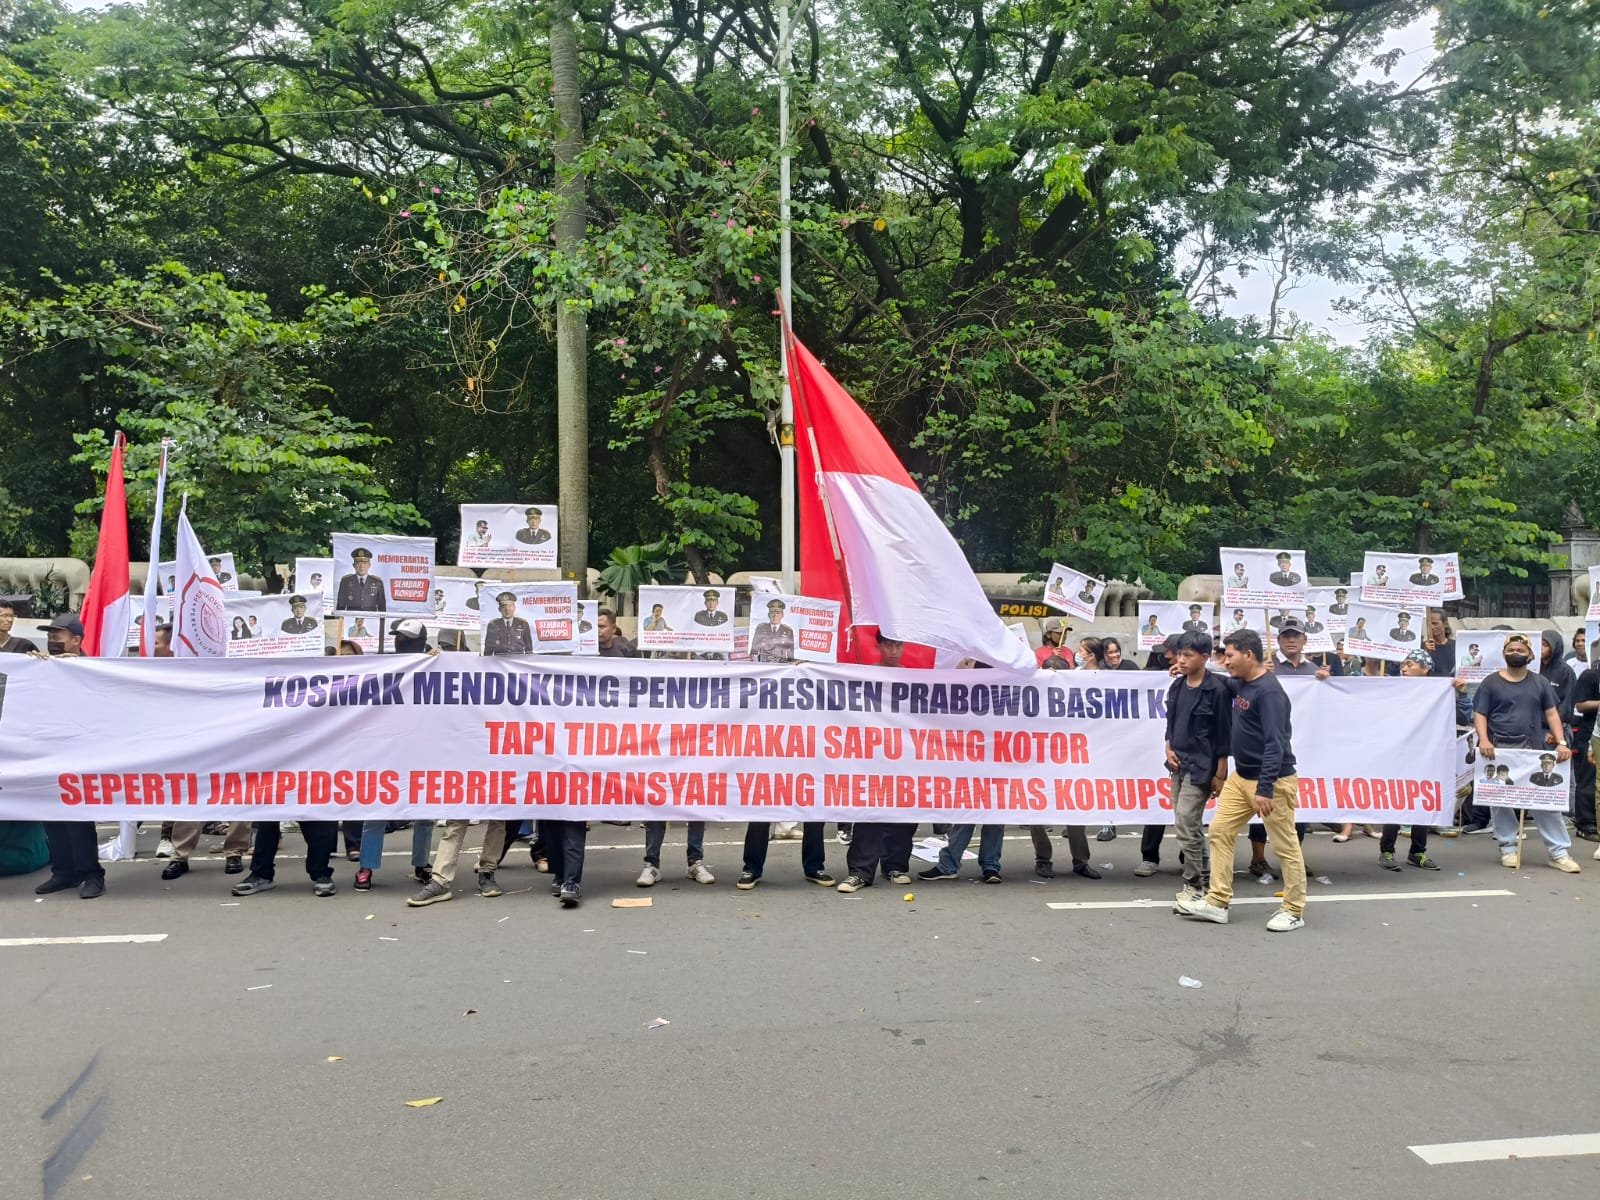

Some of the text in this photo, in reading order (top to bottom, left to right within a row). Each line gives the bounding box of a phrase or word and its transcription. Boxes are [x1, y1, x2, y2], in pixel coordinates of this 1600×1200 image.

[377, 555, 429, 565] MEMBERANTAS
[401, 566, 429, 574] KORUPSI
[393, 580, 424, 589] SEMBARI
[394, 589, 424, 598] KORUPSI
[522, 596, 571, 606] MEMBERANTAS
[544, 606, 571, 614] KORUPSI
[790, 606, 835, 619] MEMBERANTAS
[999, 603, 1048, 617] POLISI
[538, 620, 568, 629] SEMBARI
[808, 617, 834, 627] KORUPSI
[539, 629, 569, 638] KORUPSI
[801, 630, 828, 641] SEMBARI
[801, 639, 828, 649] KORUPSI
[263, 671, 1168, 720] KOSMAK MENDUKUNG PENUH PRESIDEN PRABOWO BASMI K
[485, 721, 1089, 765] TAPI TIDAK MEMAKAI SAPU YANG KOTOR
[58, 773, 199, 807] SEPERTI
[207, 771, 400, 806] JAMPIDSUS
[408, 771, 517, 806] FEBRIE
[523, 772, 728, 807] ADRIANSYAH
[736, 773, 815, 808] YANG
[823, 775, 1048, 811] MEMBERANTAS
[1054, 777, 1174, 811] KORUPS
[1333, 778, 1442, 813] KORUPSI
